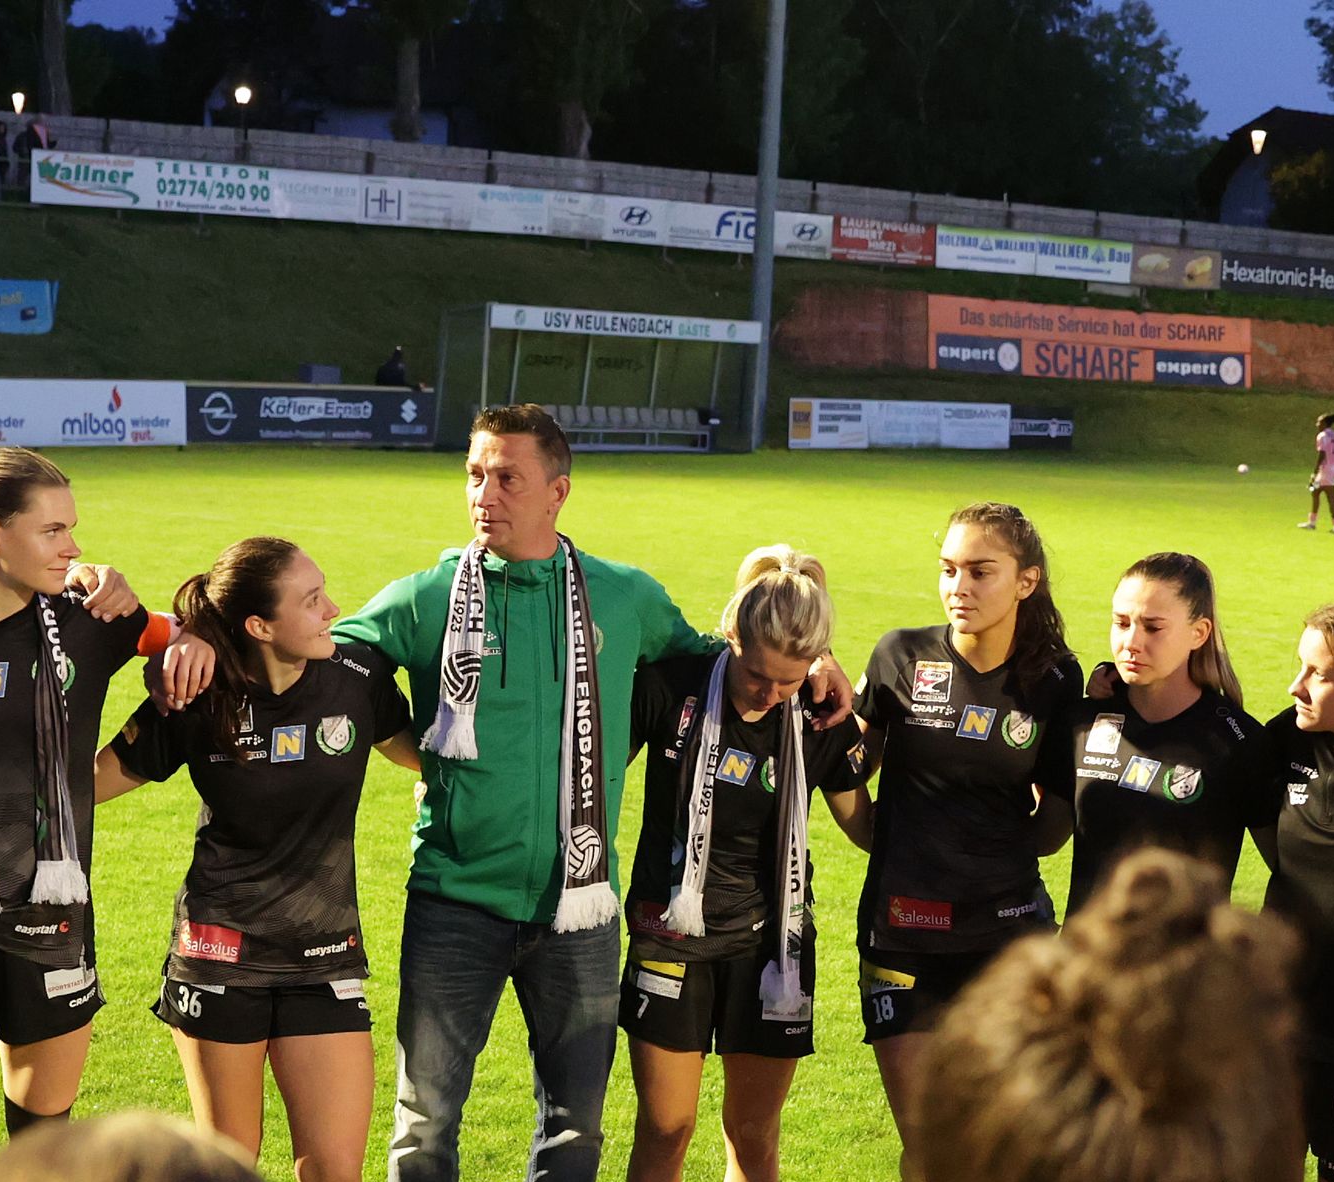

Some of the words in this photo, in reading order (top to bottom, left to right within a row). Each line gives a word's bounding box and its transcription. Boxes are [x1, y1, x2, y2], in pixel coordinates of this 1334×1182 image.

[37, 162, 134, 184] Wallner
[156, 161, 270, 182] TELEFON
[156, 179, 246, 200] 02774/290
[250, 185, 271, 201] 90
[1038, 241, 1089, 259] WALLNER
[1222, 260, 1308, 288] Hexatronic
[544, 311, 571, 330] USV
[574, 314, 673, 336] NEULENGBACH
[960, 305, 987, 326] Das
[989, 309, 1055, 332] schärfste
[1058, 313, 1110, 336] Service
[1113, 321, 1137, 338] hat
[1140, 322, 1162, 339] der
[1167, 323, 1226, 342] SCHARF
[938, 346, 995, 361] expert
[1034, 343, 1140, 379] SCHARF
[1156, 360, 1217, 378] expert
[62, 411, 126, 443] mibag
[131, 416, 171, 429] wieder
[456, 561, 471, 596] SEIT
[450, 598, 466, 634] 1923
[343, 658, 371, 678] ebcont
[910, 703, 946, 714] CRAFT
[698, 784, 714, 817] 1923
[898, 910, 951, 925] salexius
[14, 923, 58, 936] easystaff
[185, 937, 239, 958] salexius
[303, 941, 348, 958] easystaff
[178, 984, 204, 1019] 36
[637, 993, 650, 1019] 7
[872, 994, 895, 1024] 18
